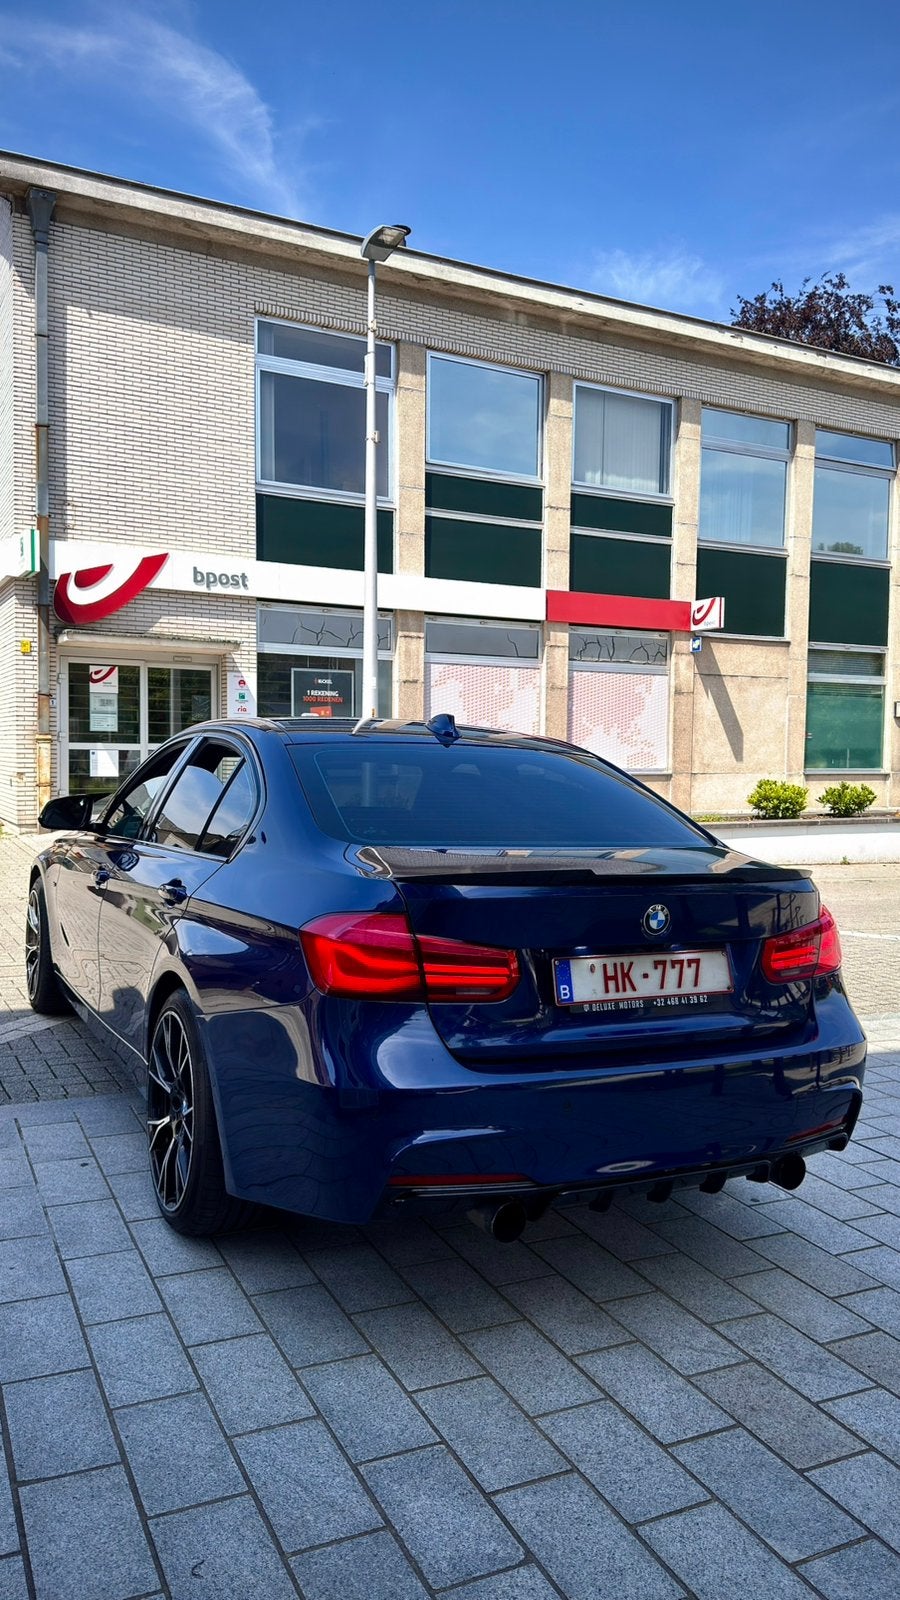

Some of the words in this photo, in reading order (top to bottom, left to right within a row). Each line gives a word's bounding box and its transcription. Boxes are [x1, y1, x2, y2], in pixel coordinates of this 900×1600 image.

[193, 566, 248, 590] bpost
[560, 985, 570, 999] B
[592, 1003, 615, 1011] DELUXE
[619, 1001, 644, 1009] MOTORS
